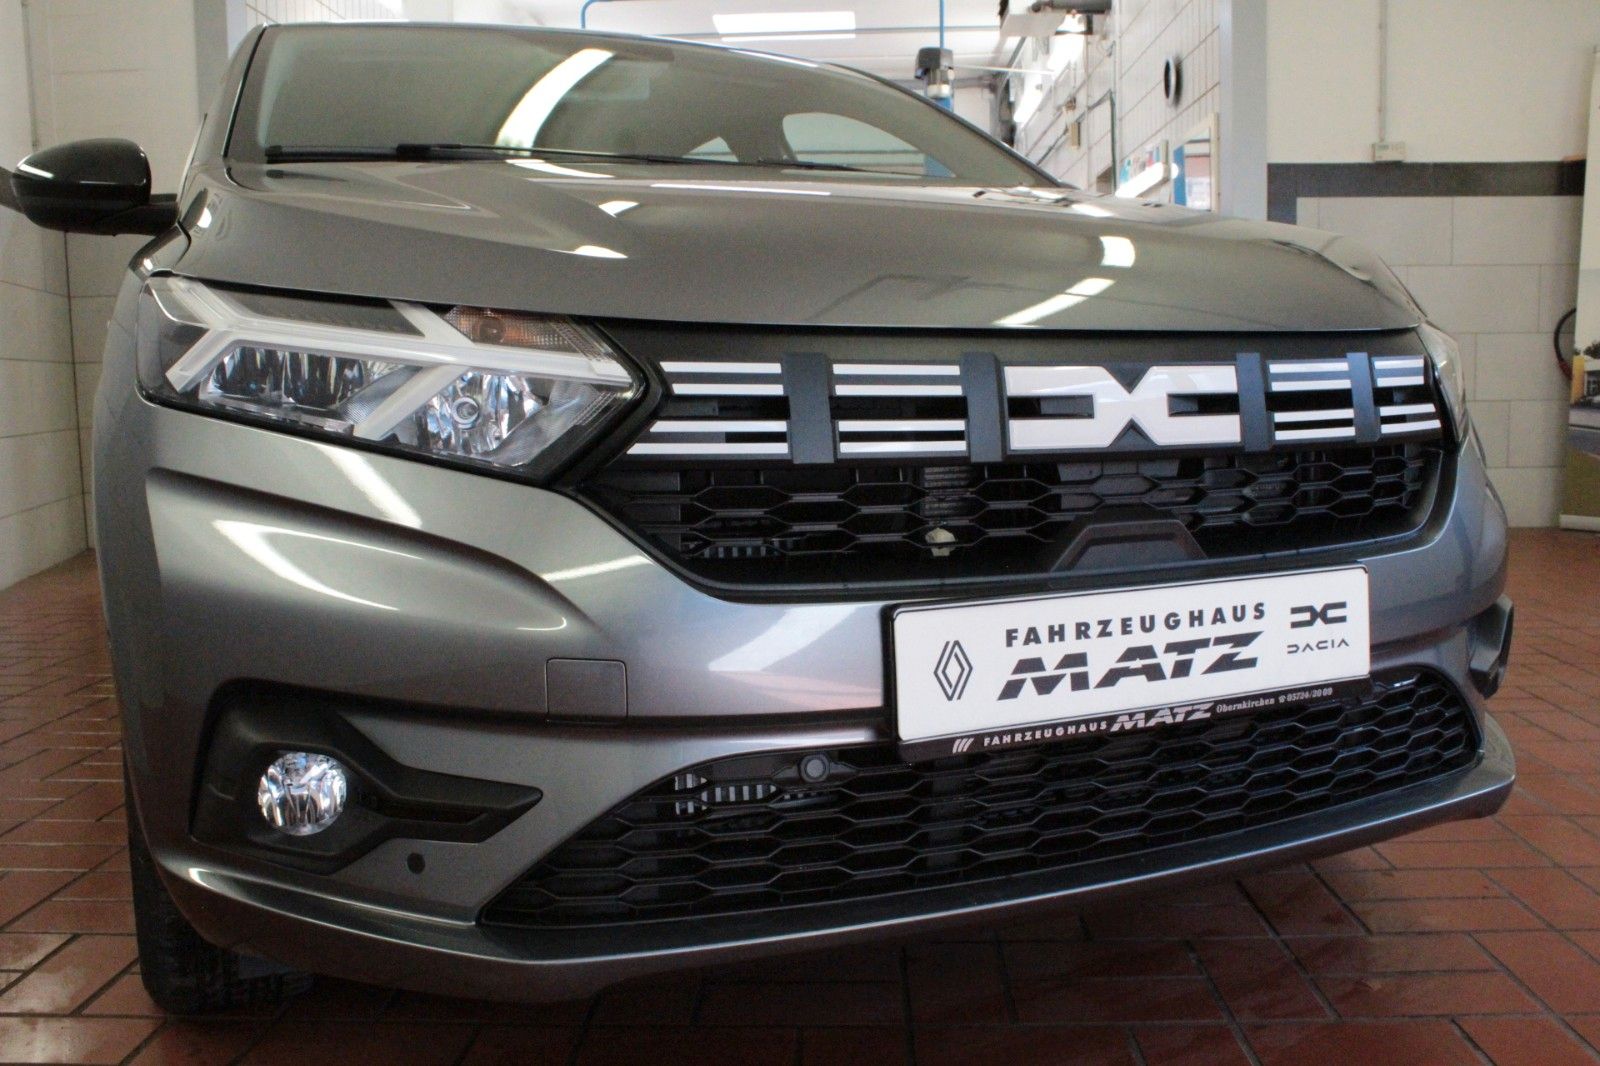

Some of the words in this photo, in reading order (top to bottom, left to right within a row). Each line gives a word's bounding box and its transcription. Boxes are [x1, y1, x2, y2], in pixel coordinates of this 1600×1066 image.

[1006, 602, 1267, 647] FAHRZEUGHAUS
[1287, 637, 1350, 654] DACIA
[998, 631, 1264, 700] MATZ
[983, 721, 1108, 747] FAHRZEUGHAUS
[1109, 702, 1214, 733] MATZ
[1215, 697, 1275, 714] Obernkirchen
